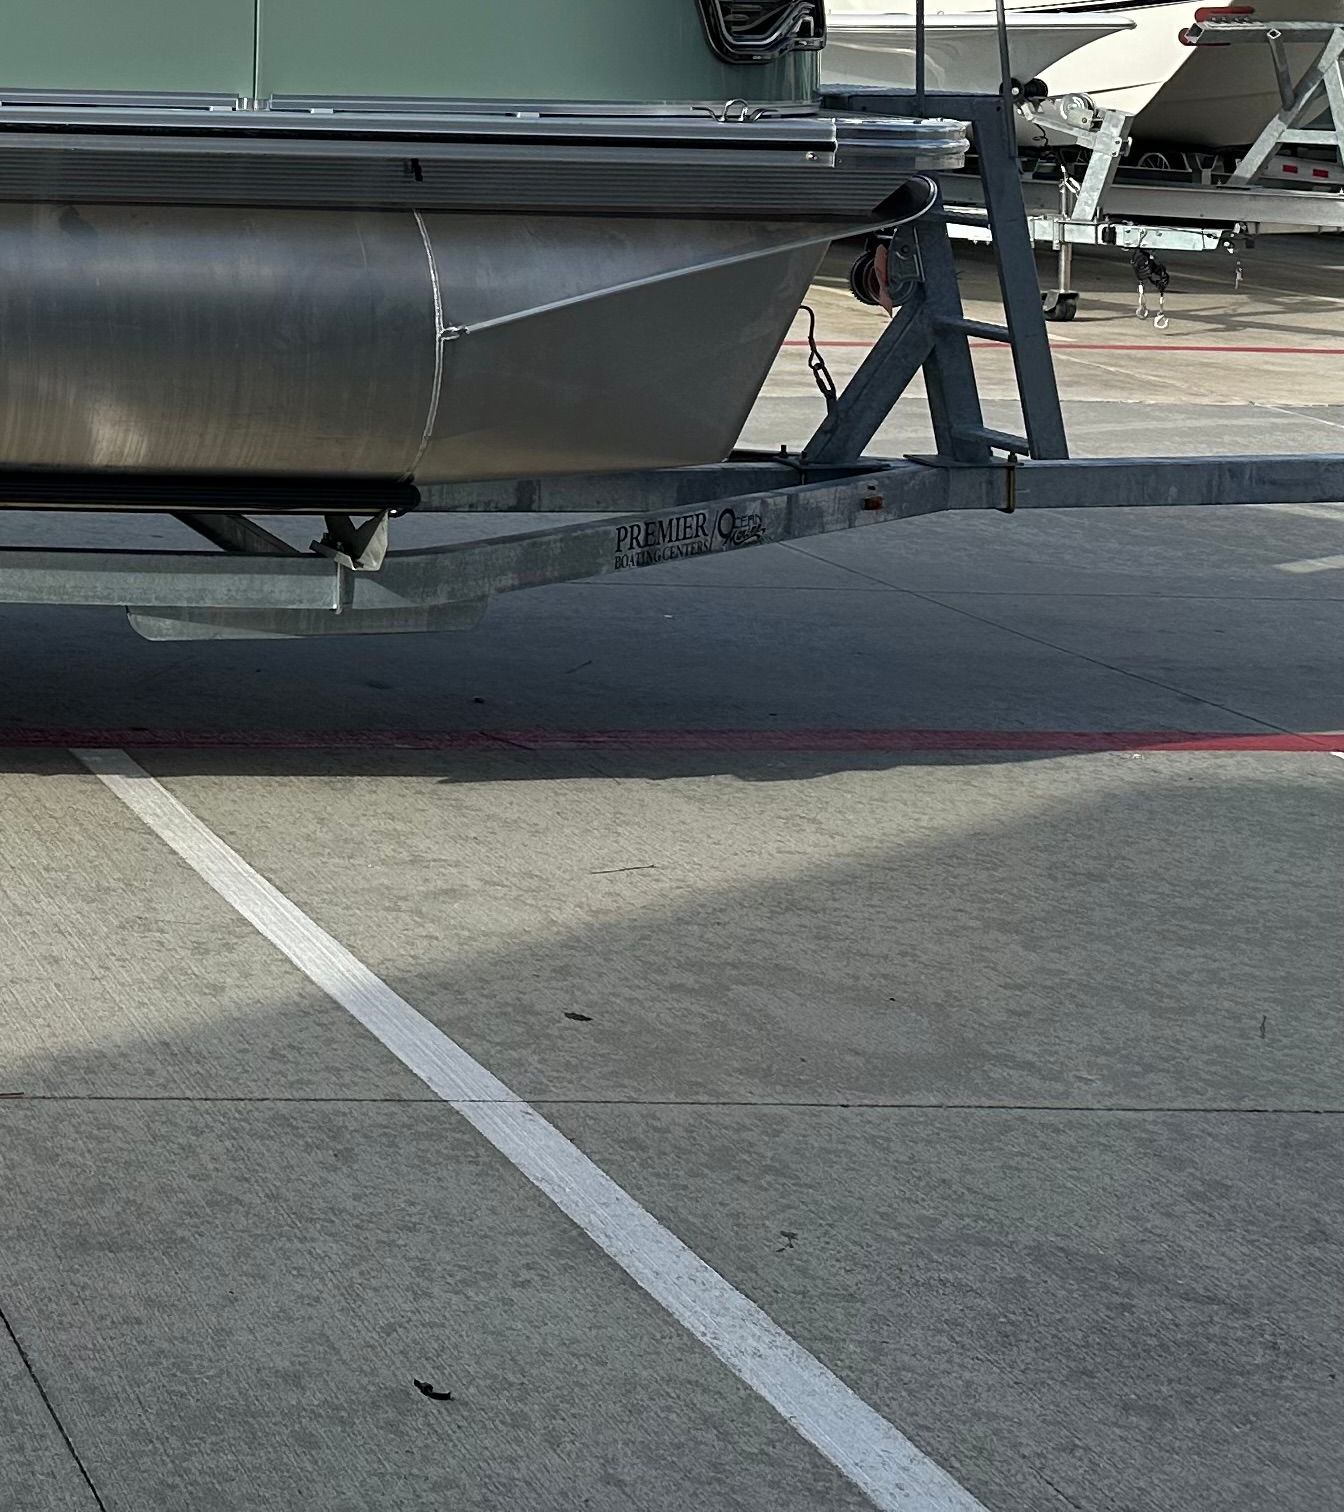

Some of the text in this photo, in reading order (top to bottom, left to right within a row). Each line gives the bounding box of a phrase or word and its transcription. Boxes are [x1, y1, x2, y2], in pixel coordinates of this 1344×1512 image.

[615, 512, 709, 553] PREMIER
[614, 539, 709, 569] BOATING CENTERS
